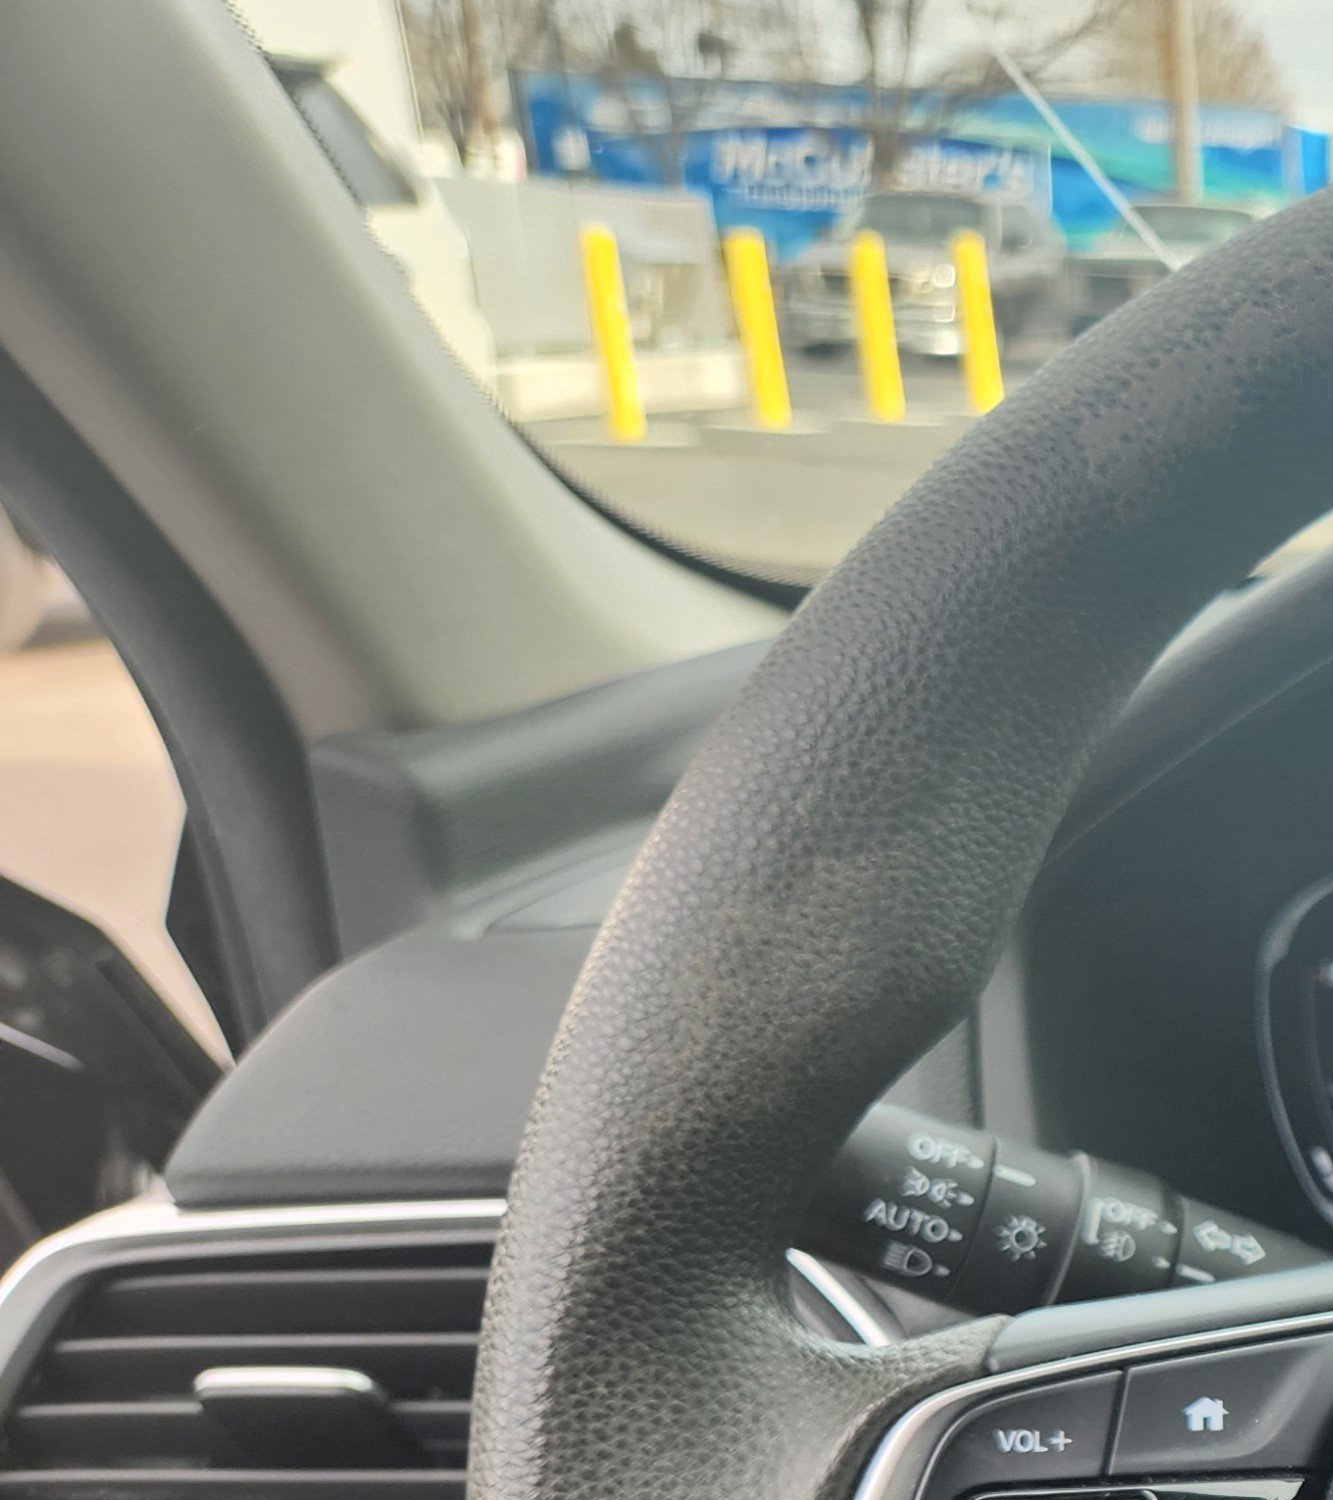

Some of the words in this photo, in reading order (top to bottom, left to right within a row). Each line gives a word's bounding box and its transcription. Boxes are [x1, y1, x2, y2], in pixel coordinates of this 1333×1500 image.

[906, 1133, 970, 1169] OFF
[864, 1198, 950, 1243] AUTO
[1102, 1197, 1159, 1231] OFF
[998, 1430, 1073, 1453] VOL+
